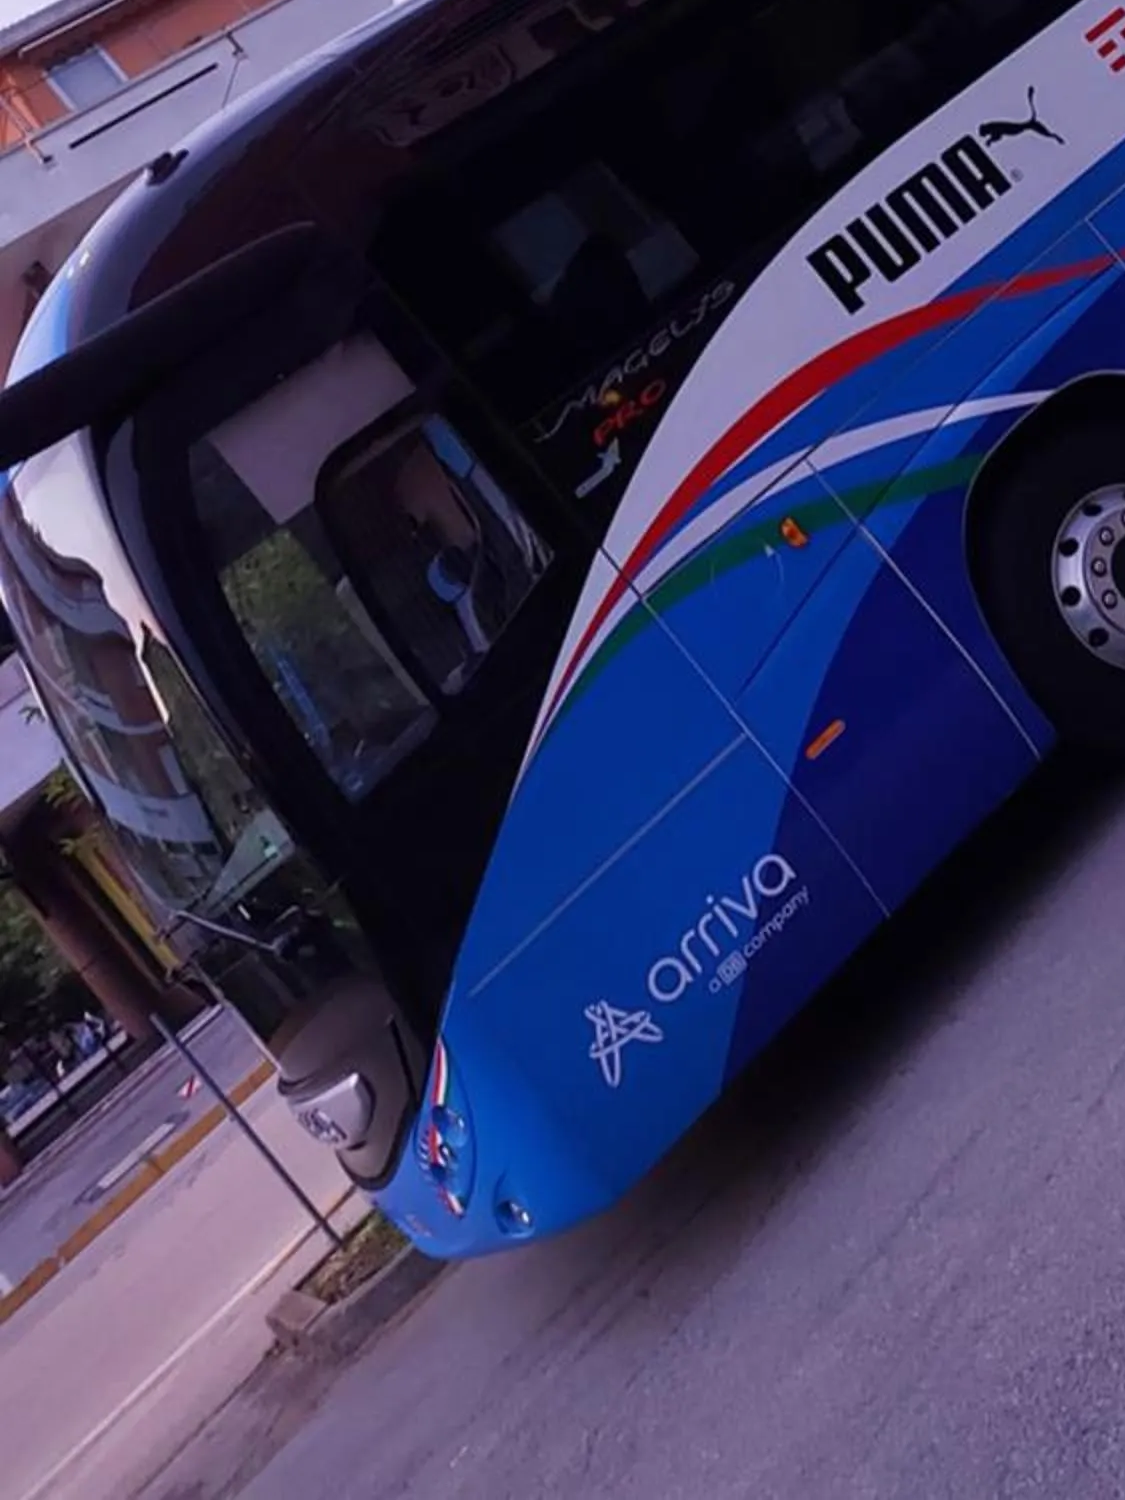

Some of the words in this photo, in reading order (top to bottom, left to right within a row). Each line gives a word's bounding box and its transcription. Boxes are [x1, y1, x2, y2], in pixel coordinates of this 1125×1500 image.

[805, 133, 1013, 316] PUMA
[534, 281, 736, 443] MAGELYS
[593, 378, 667, 445] PRO
[648, 853, 796, 1002] arriva
[708, 976, 722, 994] a
[743, 885, 809, 958] company
